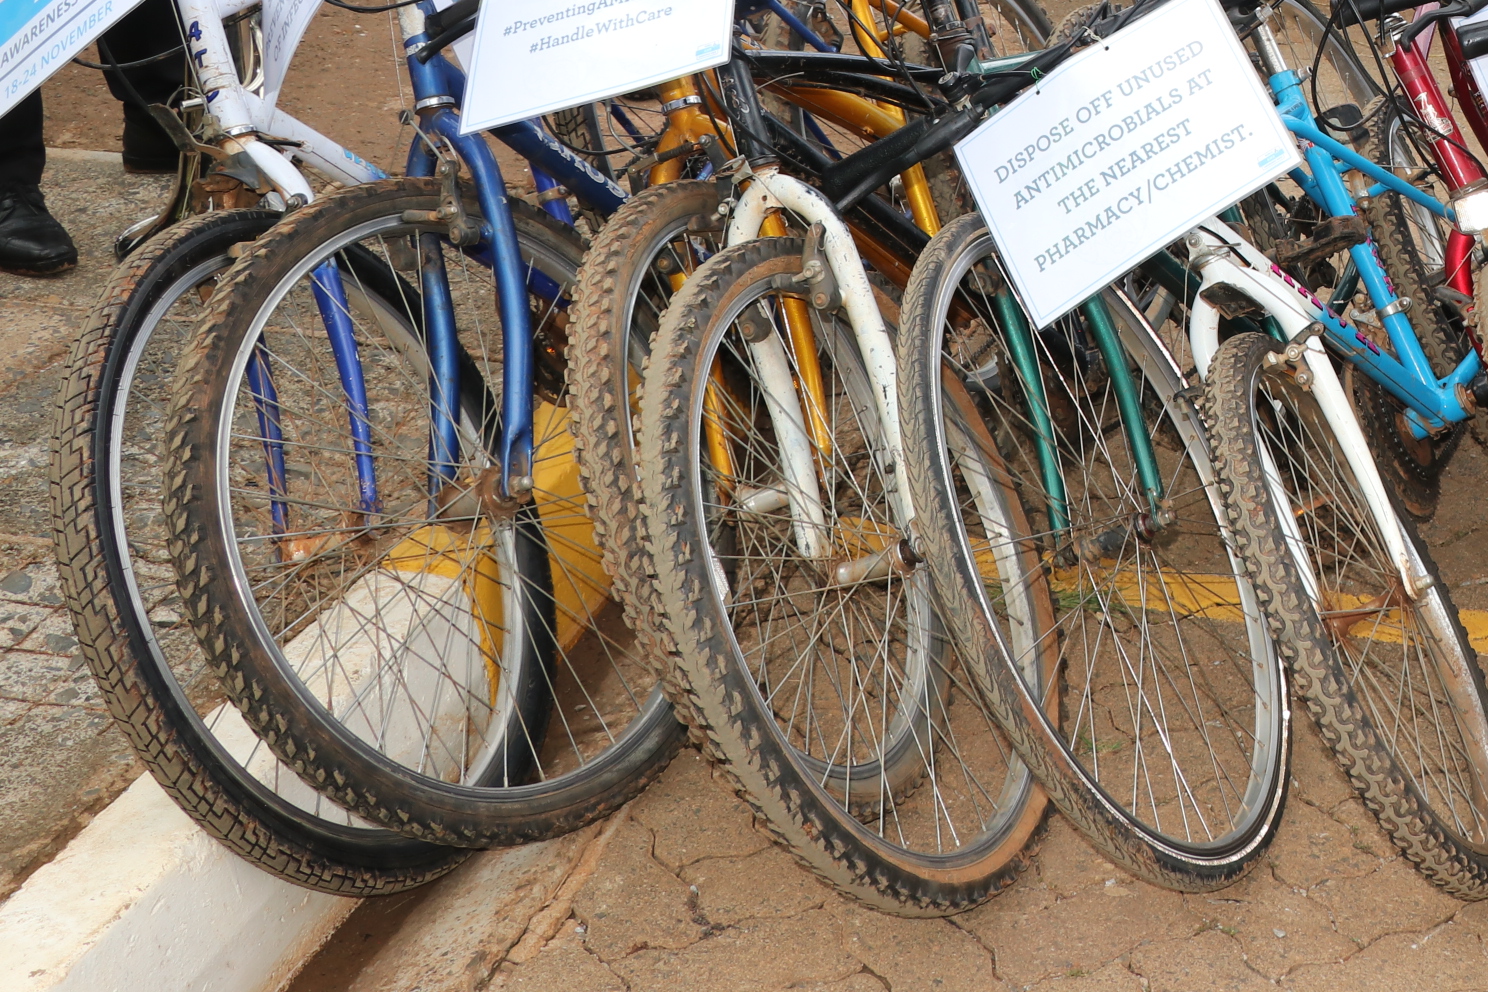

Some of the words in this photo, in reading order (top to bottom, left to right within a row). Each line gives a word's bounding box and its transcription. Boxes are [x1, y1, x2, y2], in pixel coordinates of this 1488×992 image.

[4, 66, 38, 99] 18-24
[40, 0, 114, 69] NOVEMBER
[529, 6, 673, 54] #HandleWithCare
[993, 118, 1074, 184] DISPOSE
[1075, 90, 1115, 124] OFF
[1117, 40, 1204, 97] UNUSED
[1013, 88, 1183, 210] ANTIMICROBIALS
[1181, 68, 1215, 98] AT
[1057, 179, 1101, 215] THE
[1099, 118, 1193, 188] NEAREST
[1033, 123, 1254, 273] PHARMACY/CHEMIST.
